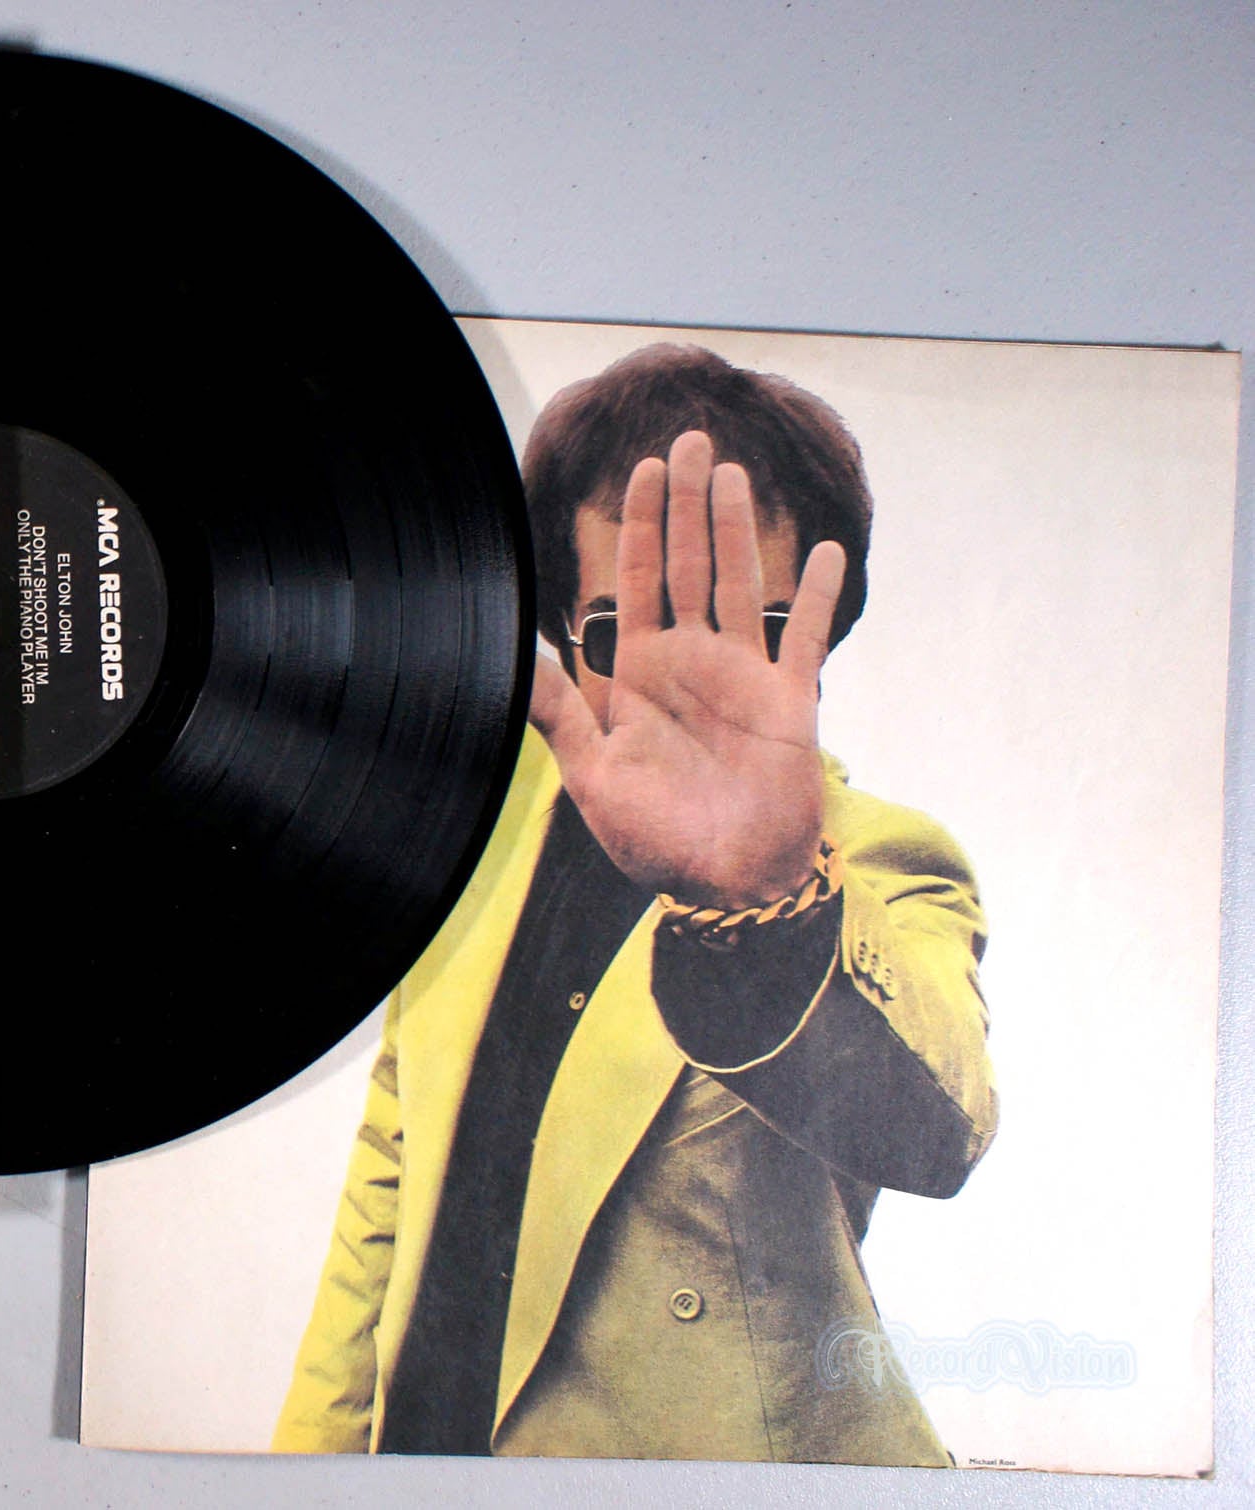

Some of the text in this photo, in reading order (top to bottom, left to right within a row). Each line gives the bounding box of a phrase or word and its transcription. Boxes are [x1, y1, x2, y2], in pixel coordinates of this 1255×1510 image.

[17, 509, 35, 704] ONLY THE PIANO PLAYER
[32, 526, 49, 685] DON'T SHOOT ME I'M
[57, 553, 73, 654] ELTON JOHN
[97, 507, 124, 701] MCA RECORDS
